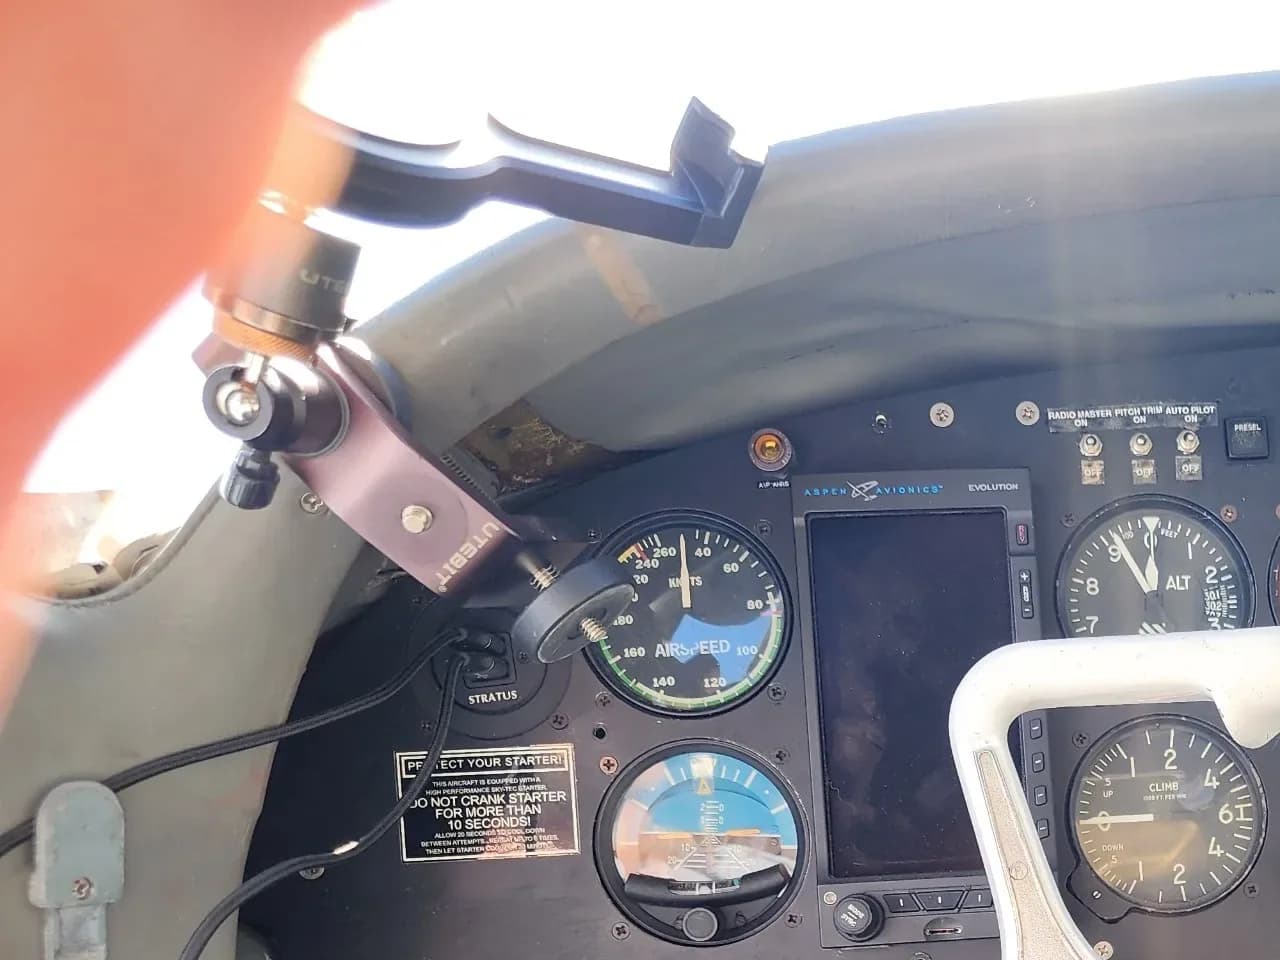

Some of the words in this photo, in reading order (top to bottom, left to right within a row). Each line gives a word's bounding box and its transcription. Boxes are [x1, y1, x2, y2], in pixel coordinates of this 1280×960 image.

[1048, 411, 1076, 420] RADIO
[1077, 411, 1112, 419] MASTER
[1115, 408, 1140, 417] PITCH
[1141, 406, 1163, 415] TRIM
[1165, 406, 1189, 415] AUTO
[1191, 406, 1215, 415] PILOT
[1074, 419, 1088, 428] ON
[1133, 416, 1147, 424] ON
[1184, 415, 1198, 423] ON
[804, 488, 846, 496] ASPEN
[968, 483, 1018, 492] EVOLUTION
[653, 547, 676, 558] 260
[695, 548, 711, 557] 40
[635, 560, 660, 570] 240
[723, 563, 739, 573] 60
[1166, 575, 1191, 590] ALT
[747, 600, 763, 610] 80
[623, 648, 646, 658] 160
[655, 639, 730, 658] AIRSPEED
[736, 646, 758, 656] 100
[653, 677, 675, 687] 140
[704, 677, 727, 687] 120
[468, 689, 518, 705] STRATUS
[468, 758, 502, 769] YOUR
[505, 755, 562, 767] STARTER!
[1203, 768, 1220, 789] 4
[1149, 782, 1179, 792] CLIMB
[430, 797, 458, 807] NOT
[461, 794, 506, 806] CRANK
[509, 791, 566, 804] STARTER
[435, 808, 463, 819] FOR
[466, 806, 504, 818] MORE
[507, 804, 542, 816] THAN
[447, 820, 462, 831] 10
[465, 816, 531, 830] SECONDS!
